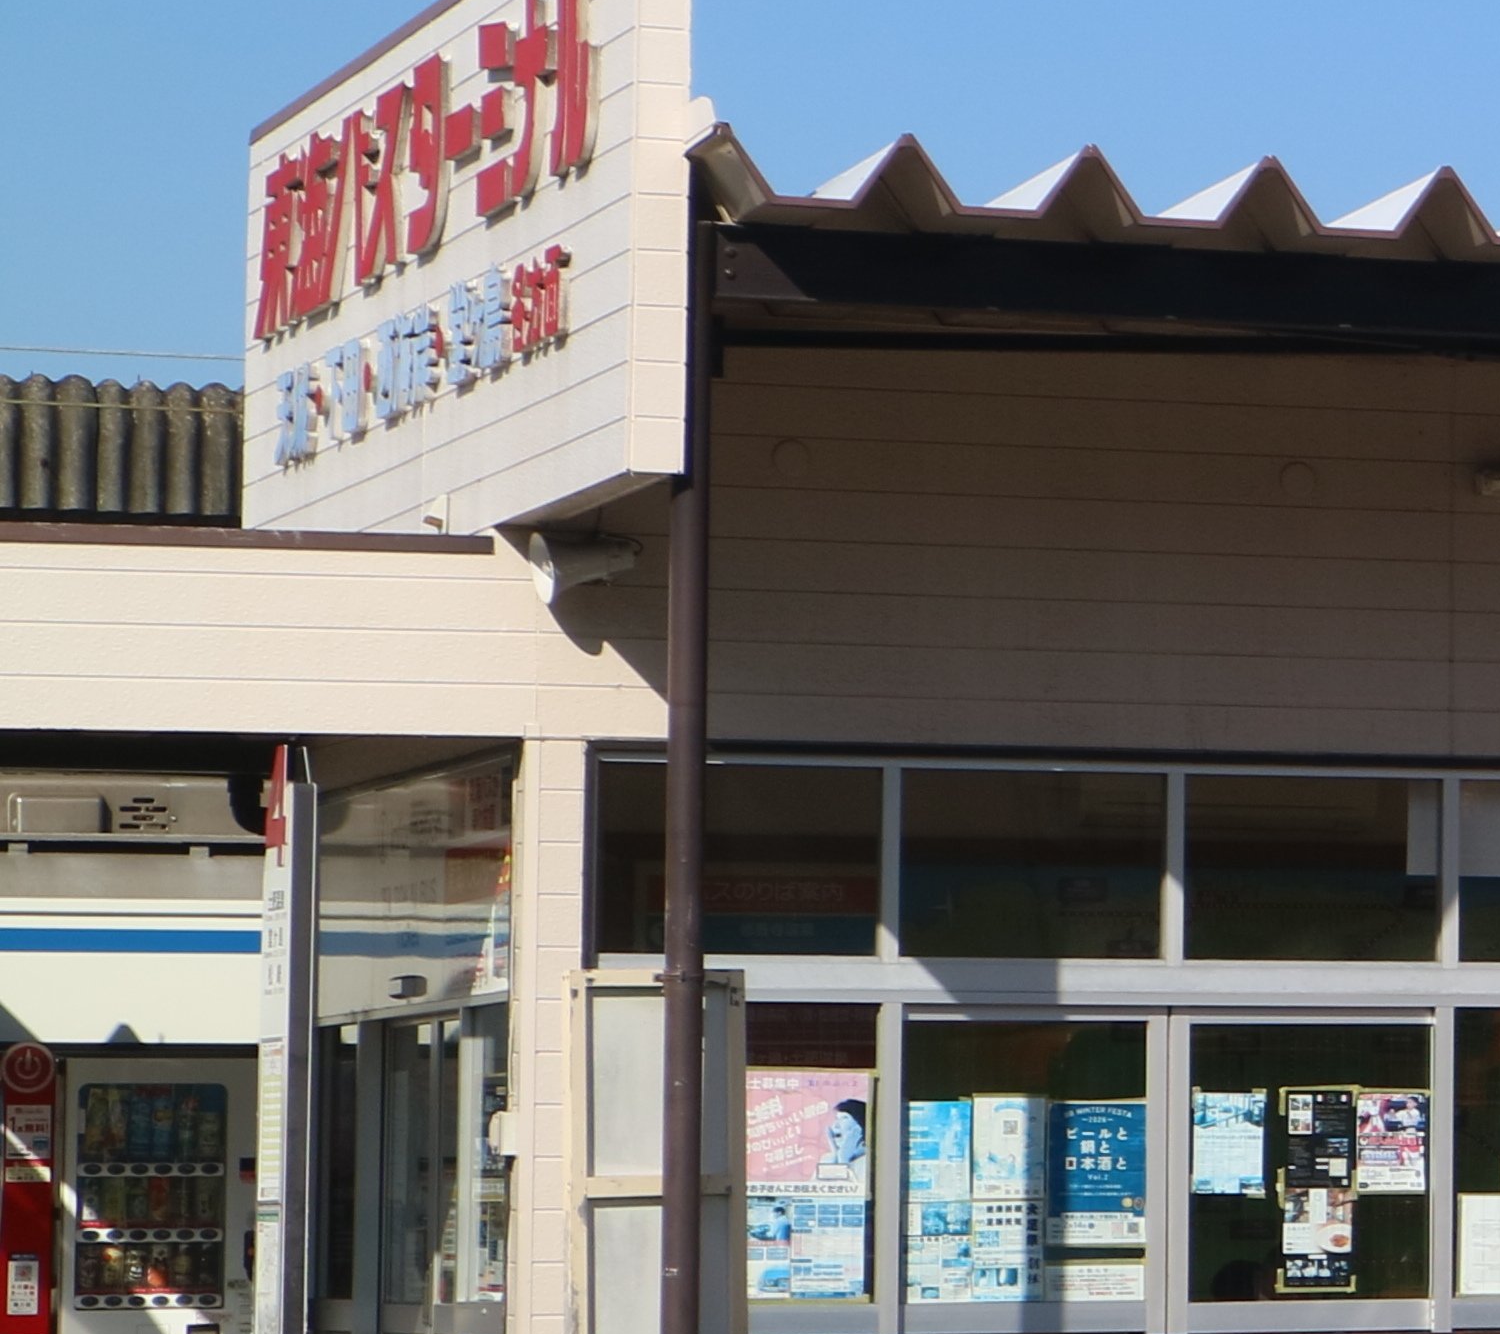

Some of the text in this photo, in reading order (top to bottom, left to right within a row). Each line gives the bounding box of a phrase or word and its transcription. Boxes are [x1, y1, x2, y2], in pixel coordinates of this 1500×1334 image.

[1066, 1127, 1128, 1140] ビールと
[1065, 1156, 1127, 1170] 日本酒と
